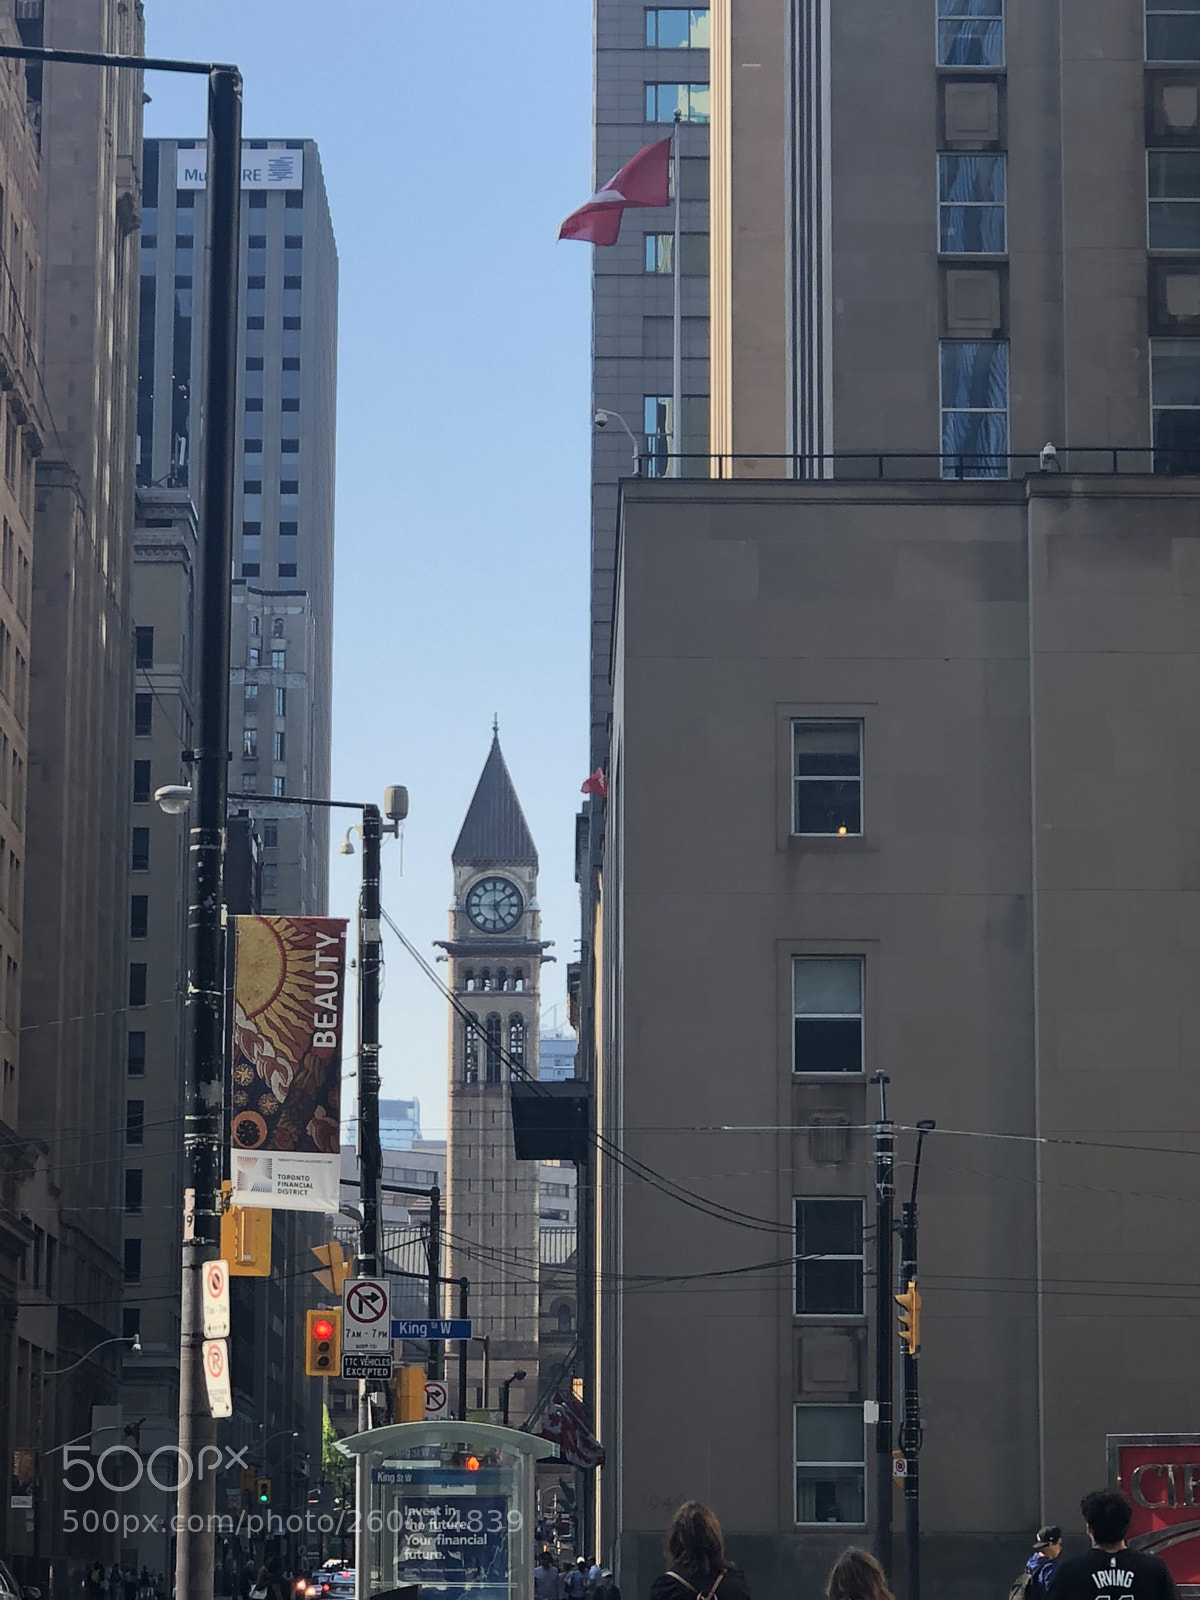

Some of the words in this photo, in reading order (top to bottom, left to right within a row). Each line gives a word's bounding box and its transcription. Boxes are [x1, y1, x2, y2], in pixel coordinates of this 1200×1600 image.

[313, 932, 339, 1049] BEAUTY
[277, 1174, 310, 1182] TORONTO
[277, 1181, 314, 1189] FINANCIAL
[400, 1321, 427, 1337] King
[440, 1322, 451, 1334] W
[345, 1358, 358, 1366] TTC
[360, 1357, 391, 1366] VEHICLES
[346, 1367, 388, 1376] EXCEPTED
[377, 1471, 395, 1484] King
[404, 1505, 442, 1516] Invest
[445, 1504, 457, 1516] in
[404, 1519, 426, 1530] the
[404, 1534, 432, 1545] Your
[436, 1533, 488, 1545] financial
[404, 1550, 446, 1560] future.
[1091, 1568, 1135, 1589] IRVING
